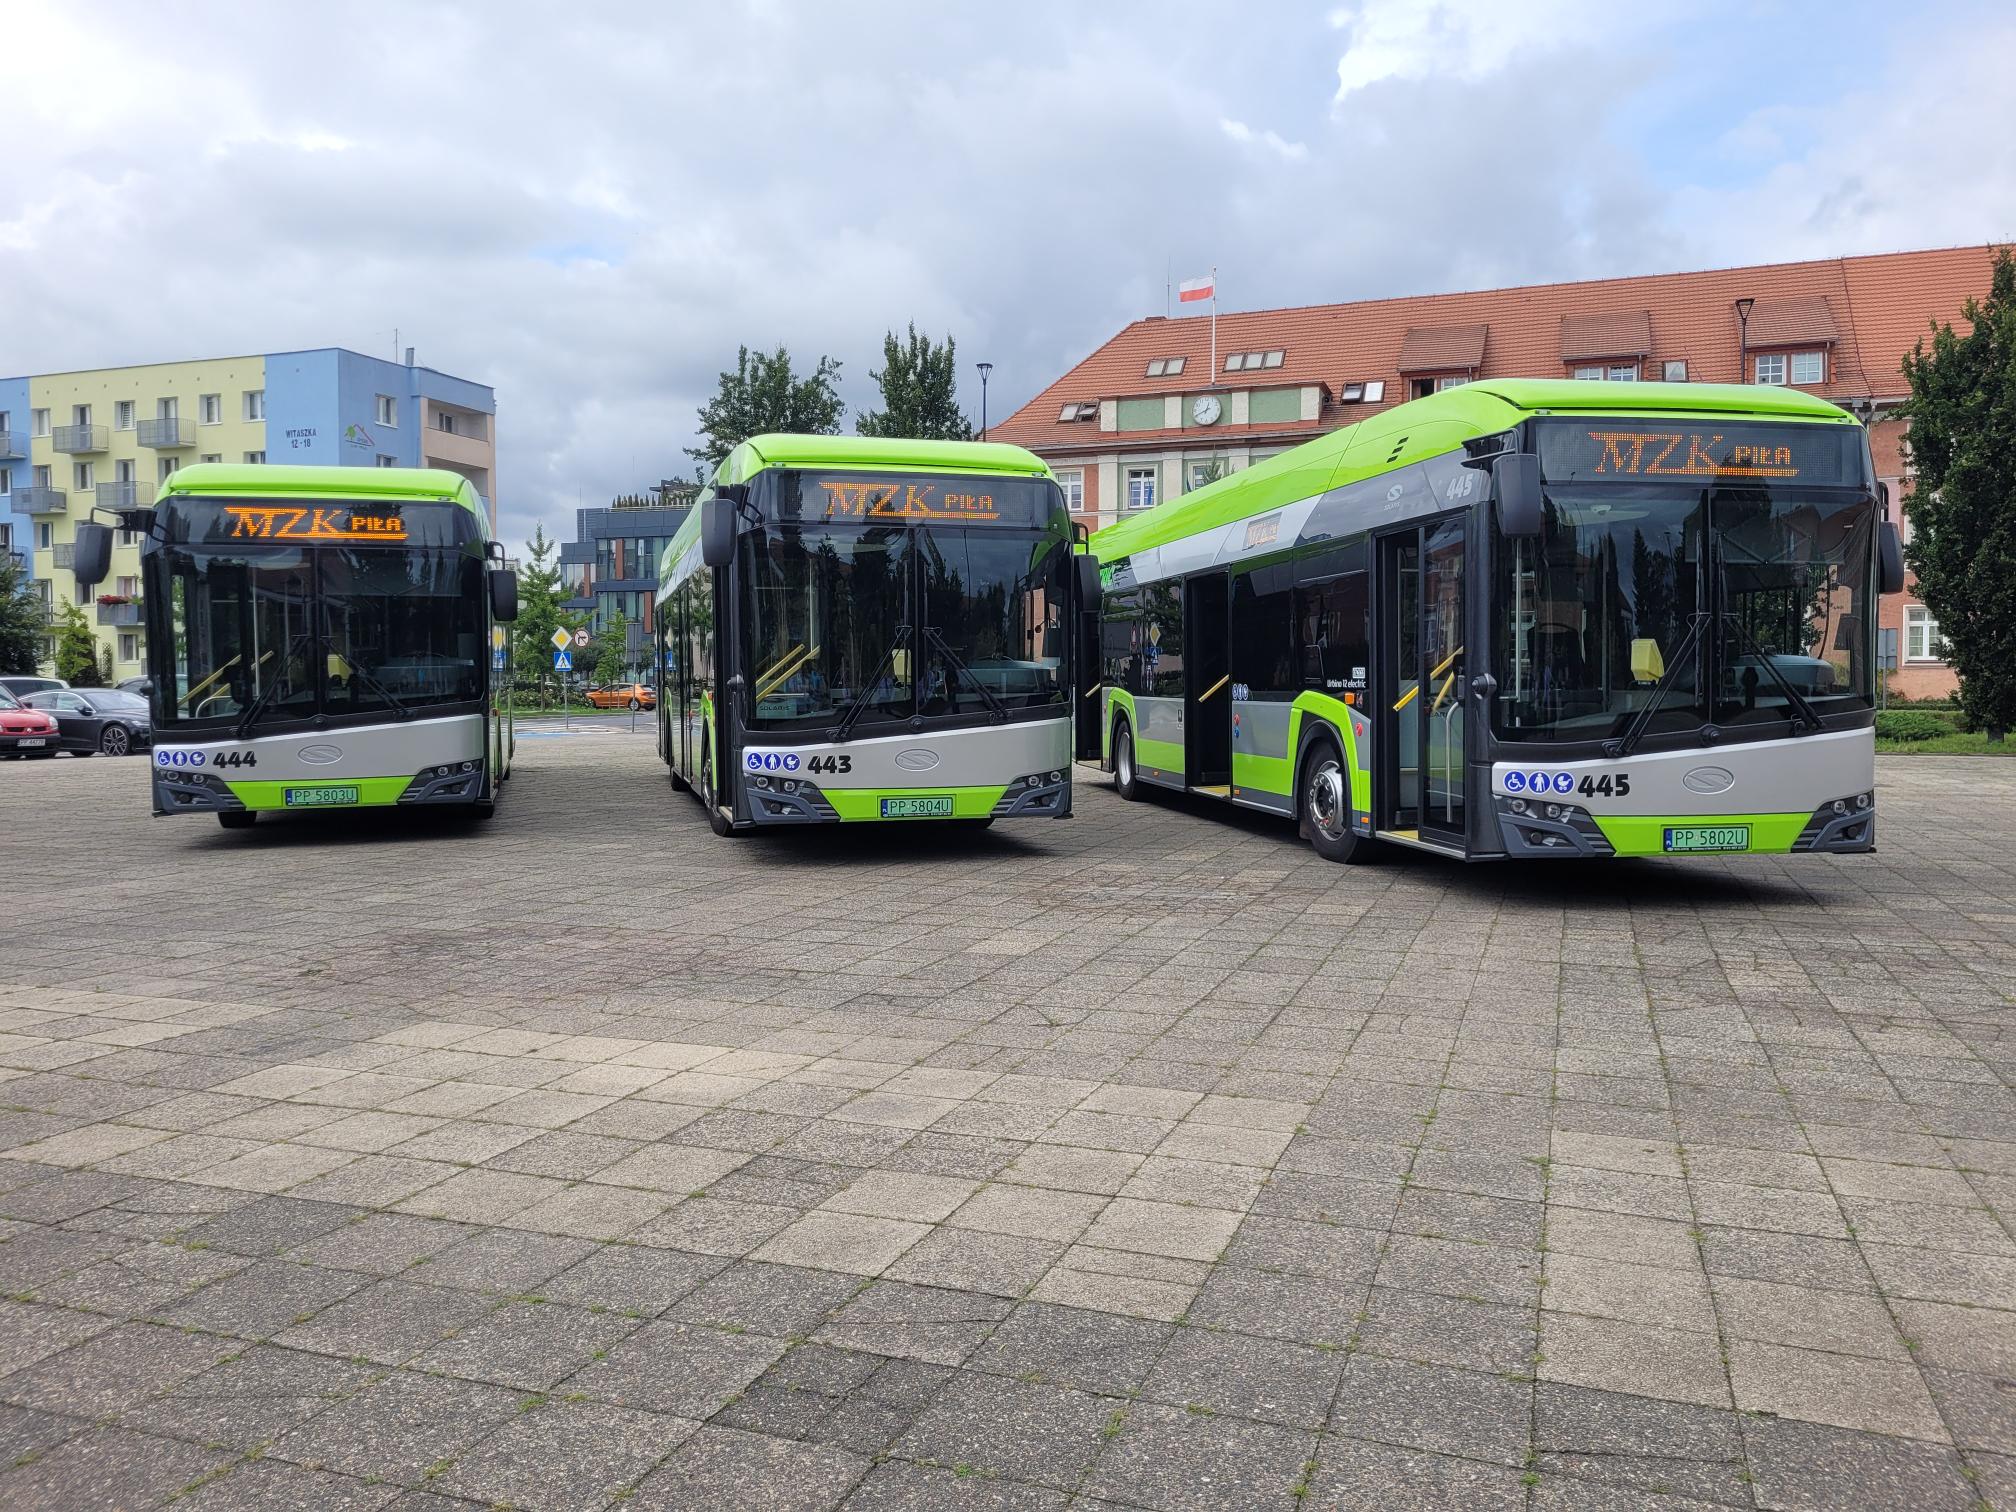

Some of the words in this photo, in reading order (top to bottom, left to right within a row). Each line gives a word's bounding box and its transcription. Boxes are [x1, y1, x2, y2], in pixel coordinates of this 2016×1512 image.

[285, 428, 317, 438] WITASZKA
[291, 439, 299, 449] 12
[1587, 431, 1724, 474] MZK
[1735, 446, 1791, 465] PIŁA
[1446, 473, 1474, 501] 445
[818, 481, 936, 518] MZK
[944, 494, 993, 510] PIŁA
[223, 507, 343, 538] MZK
[351, 516, 401, 532] PIŁA
[1326, 679, 1342, 688] Urbino
[1342, 679, 1348, 688] 12
[1347, 679, 1367, 689] electric
[213, 751, 257, 769] 444
[807, 755, 852, 774] 443
[1577, 774, 1630, 798] 445
[294, 790, 311, 802] PP
[315, 789, 355, 801] 5803U
[890, 801, 906, 813] PP
[911, 799, 949, 813] 5804U
[1675, 831, 1694, 846] PP
[1700, 829, 1744, 846] 5802U
